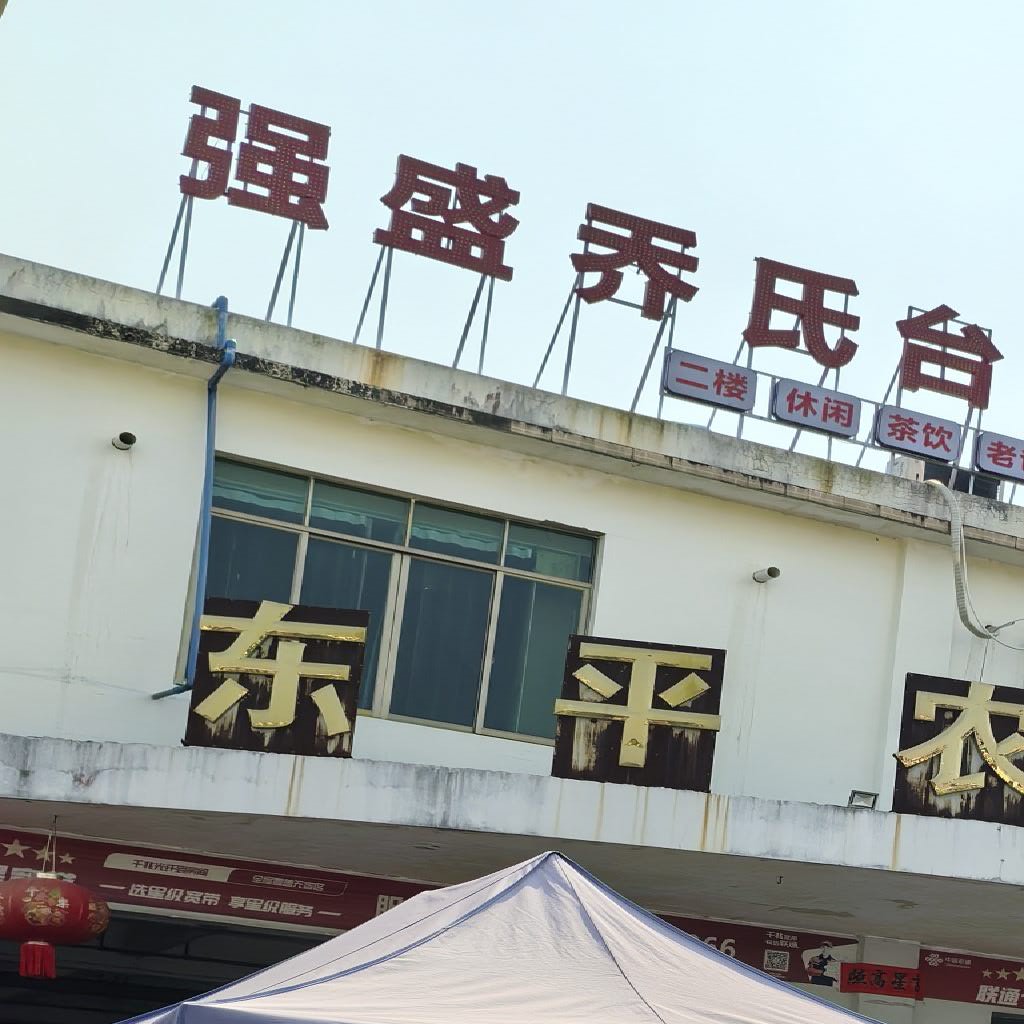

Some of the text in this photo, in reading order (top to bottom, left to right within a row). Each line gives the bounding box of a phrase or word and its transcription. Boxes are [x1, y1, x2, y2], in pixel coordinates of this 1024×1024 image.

[675, 361, 748, 400] 二楼
[786, 387, 854, 427] 休闲
[886, 413, 954, 453] 茶饮
